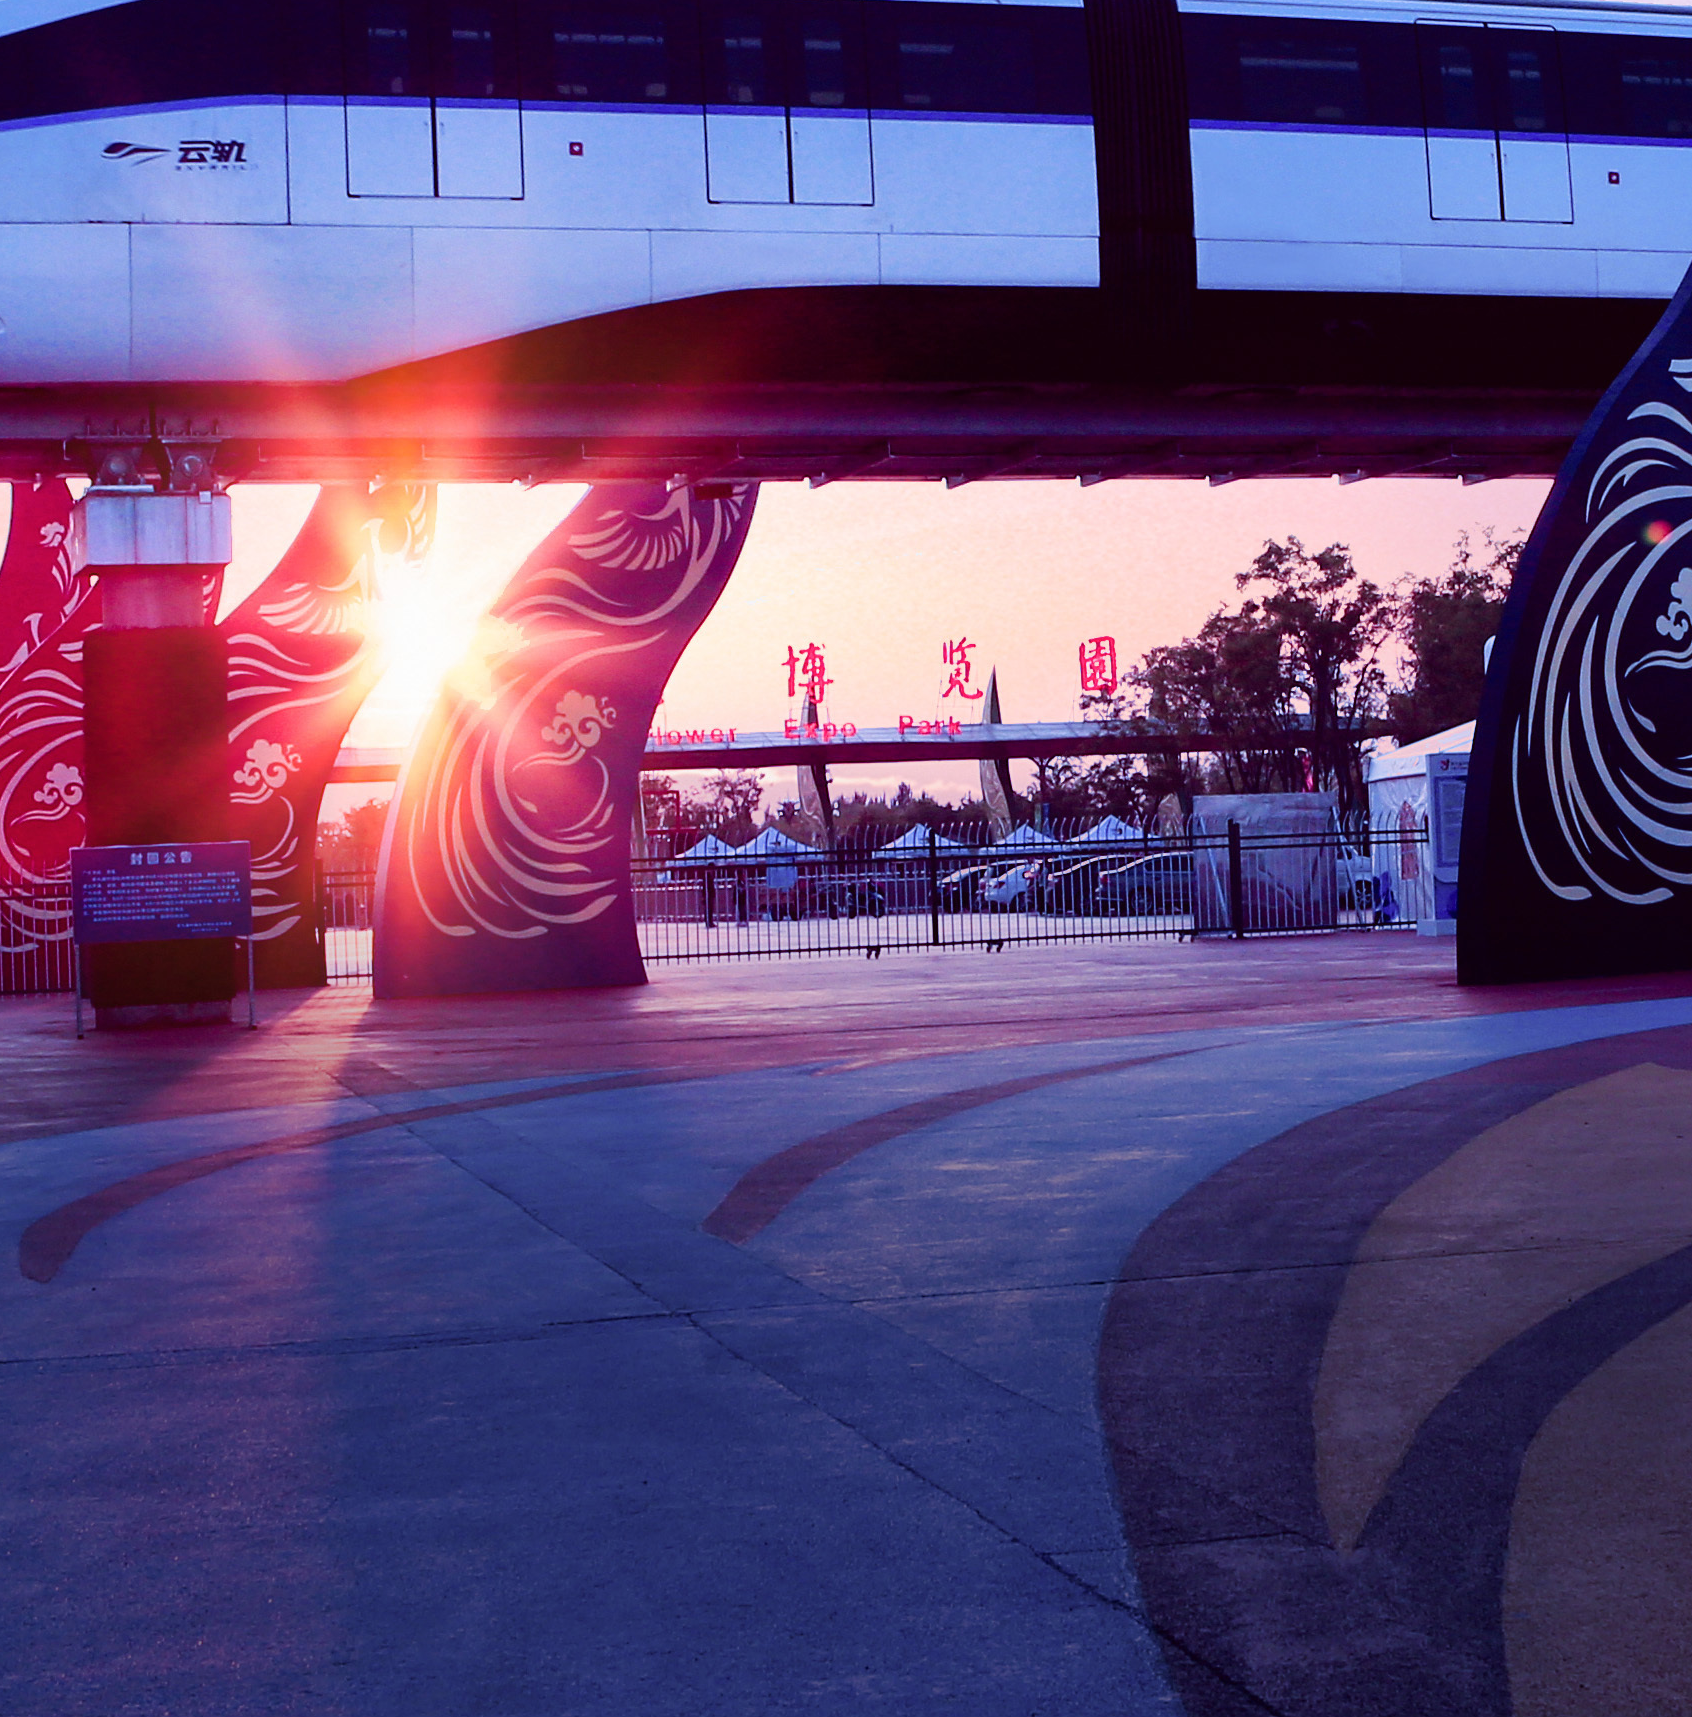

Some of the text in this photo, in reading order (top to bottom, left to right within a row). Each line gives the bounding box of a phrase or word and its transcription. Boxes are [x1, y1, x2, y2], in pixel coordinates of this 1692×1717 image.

[178, 140, 247, 163] 云轨
[650, 715, 962, 746] lower Expo Park
